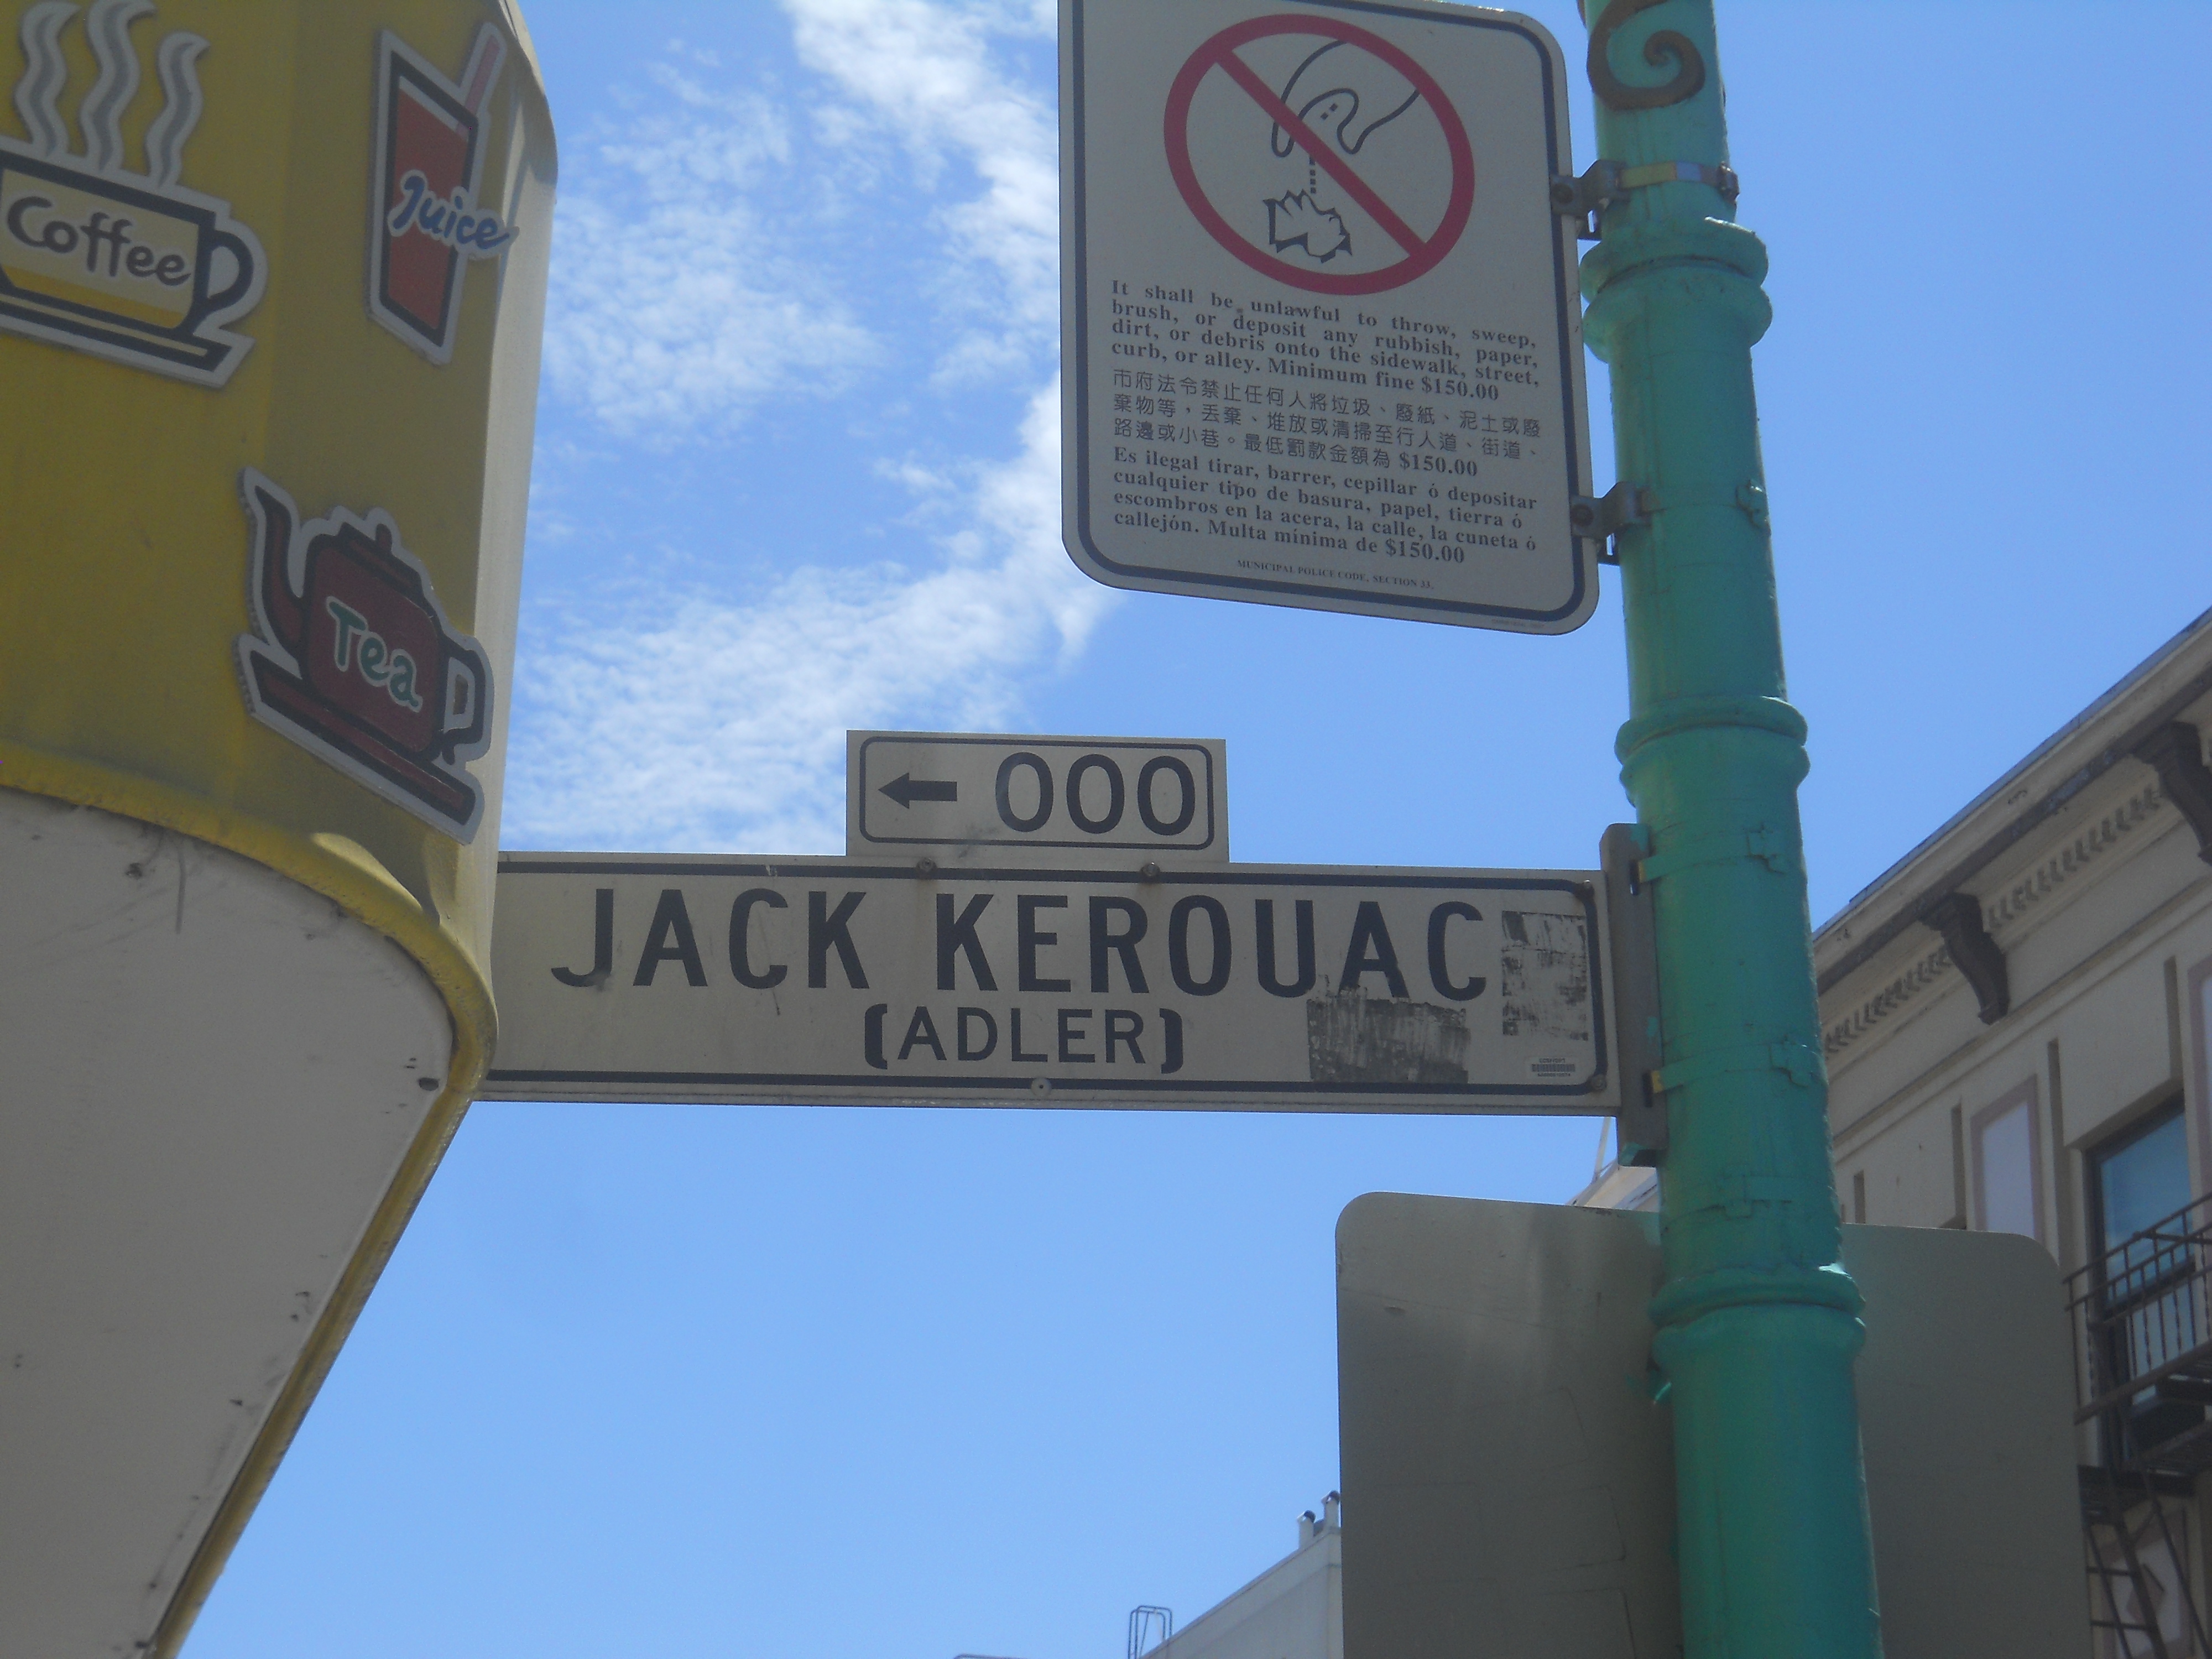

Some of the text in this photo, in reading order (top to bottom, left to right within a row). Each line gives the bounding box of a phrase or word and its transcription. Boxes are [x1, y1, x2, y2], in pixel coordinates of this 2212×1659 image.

[8, 196, 191, 286] Coffee
[390, 175, 510, 251] Juice
[1113, 280, 1535, 348] It shall be unlawful to throw, sweep,
[1113, 300, 1537, 369] brush, or deposit any rubbish, paper,
[1112, 341, 1499, 400] curb, or alley. Minimum fine $150.00
[1113, 320, 1538, 387] dirt, or debris onto the sidewalk, street,
[1115, 447, 1536, 509] Es ilegal tirar, barrer, cepillar ó depositar
[1400, 452, 1478, 476] $150.00
[1114, 472, 1522, 529] cualquier tipo de basura, papel, tierra ó
[1114, 493, 1535, 551] escombros en la acera, la calle, la cuneta ó
[1115, 512, 1465, 562] callejón. Multa mínima de $150.00
[1238, 560, 1293, 573] MUNICIPAL
[1298, 566, 1334, 577] POLICE
[1374, 576, 1417, 587] SECTION
[328, 599, 419, 708] Tea
[995, 752, 1196, 836] 000
[551, 888, 1486, 1001] JACK KEROUAC
[864, 1003, 1183, 1074] (ADLER)
